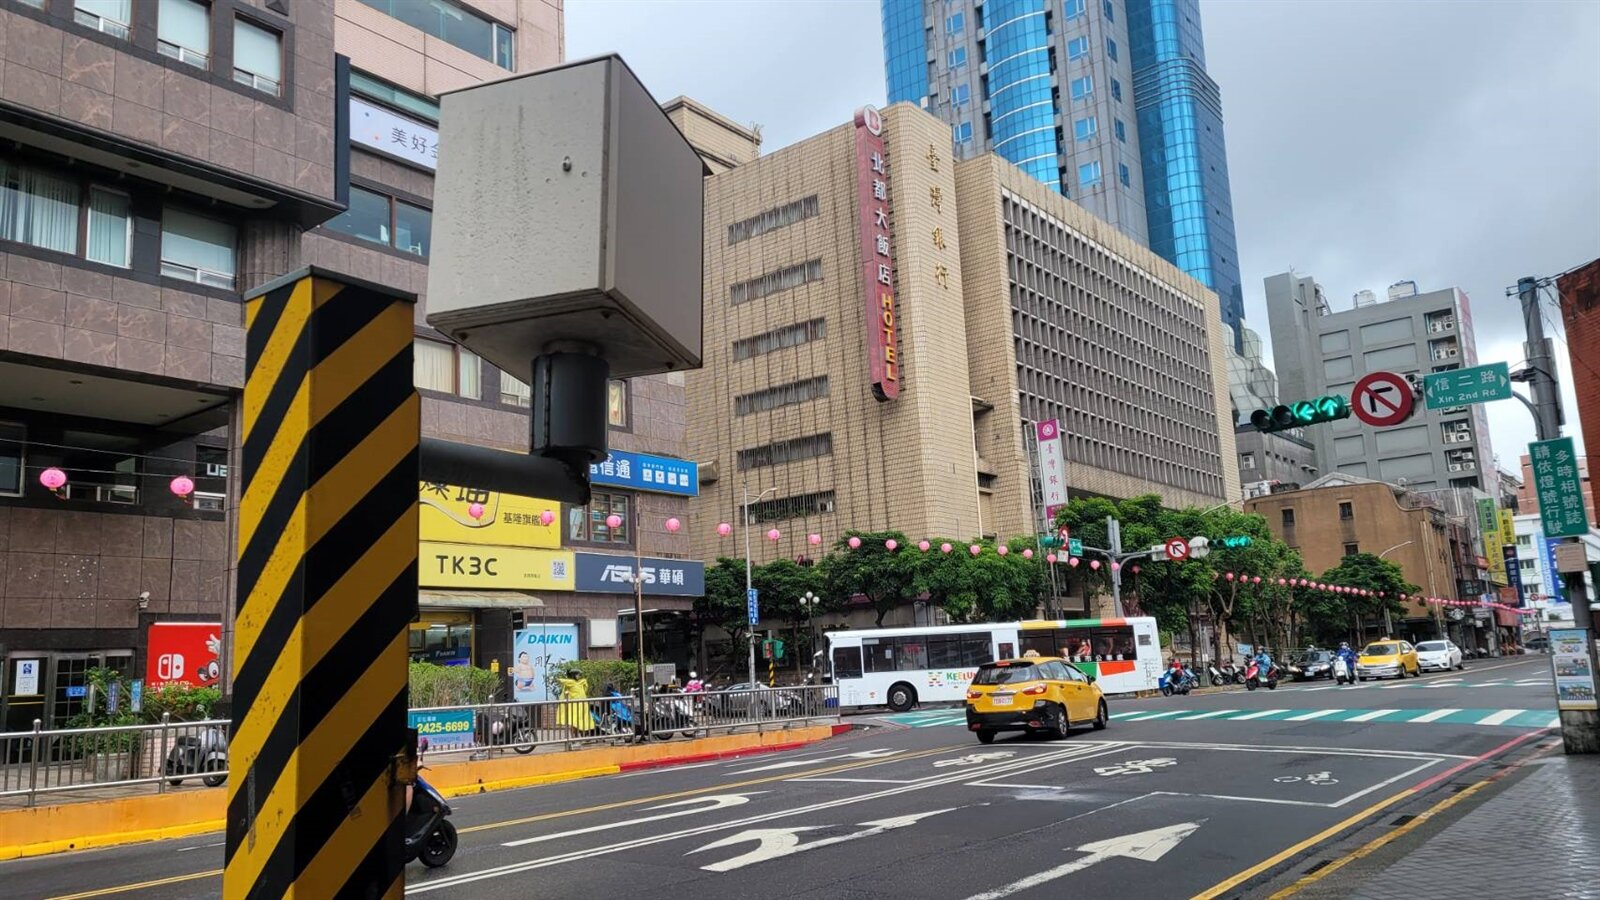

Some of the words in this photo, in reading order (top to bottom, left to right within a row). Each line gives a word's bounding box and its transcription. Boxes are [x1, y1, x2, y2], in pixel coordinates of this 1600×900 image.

[870, 151, 891, 287] 北都大飯店
[881, 293, 896, 382] HOTEL
[1434, 369, 1497, 392] 信二路
[1438, 395, 1455, 405] Xin
[1458, 390, 1479, 401] 2nd
[1482, 388, 1500, 398] Rd.
[1533, 444, 1564, 535] 請依燈號行駛
[1555, 449, 1582, 525] 多時相號誌
[503, 512, 550, 527] 基隆旗艦
[435, 555, 498, 576] TK3C
[659, 568, 685, 586] 華碩
[528, 634, 573, 645] DAIKIN
[417, 721, 470, 734] 2425-6699
